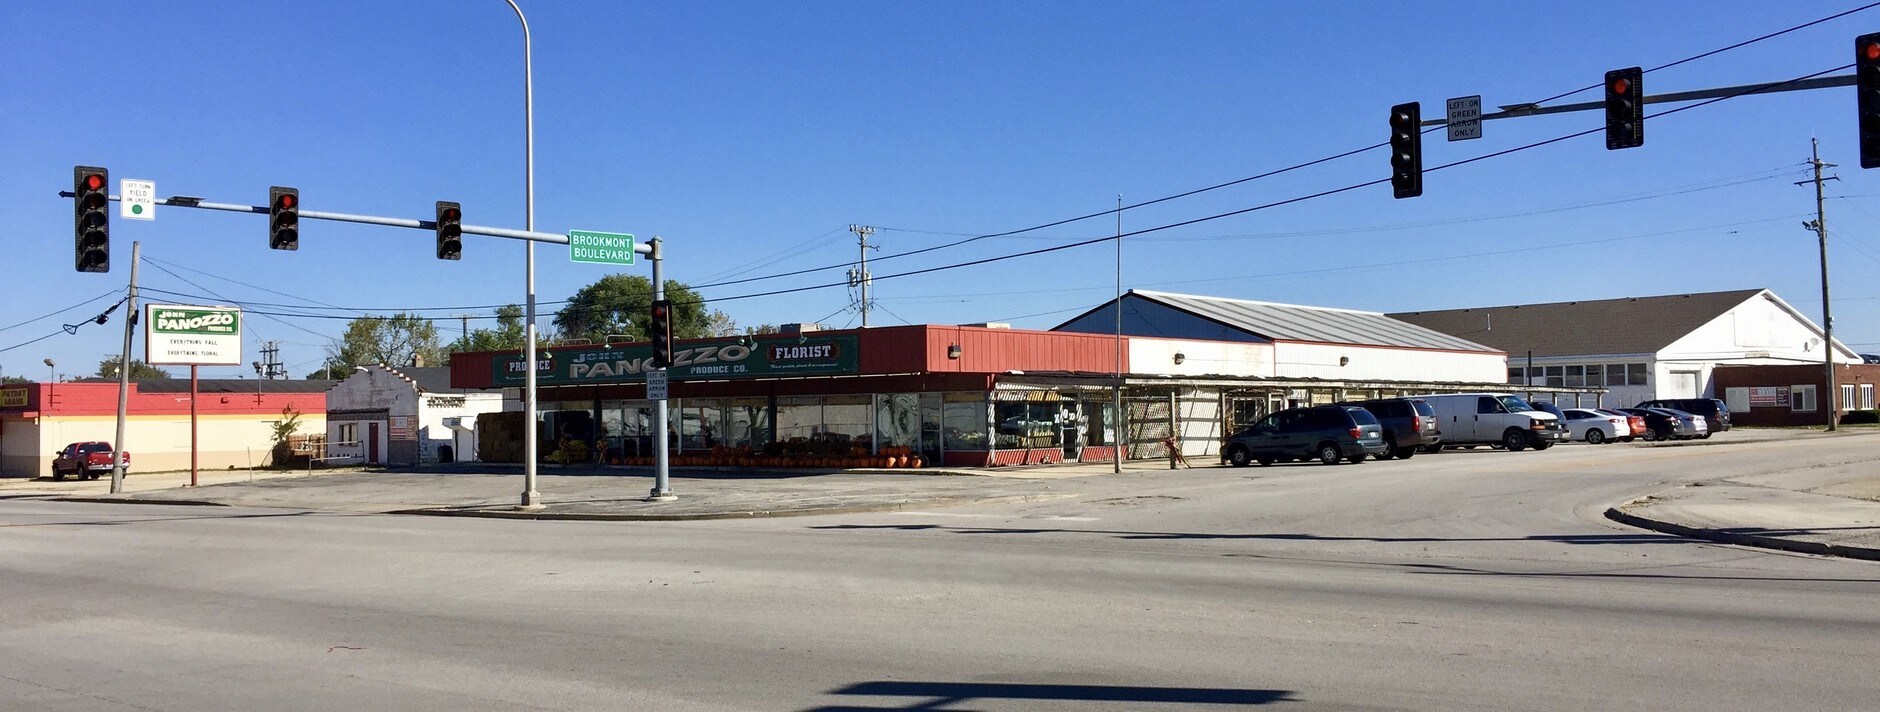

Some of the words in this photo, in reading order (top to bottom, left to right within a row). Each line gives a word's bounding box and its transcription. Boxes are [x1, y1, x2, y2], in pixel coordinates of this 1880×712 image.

[1449, 101, 1464, 109] LEFT
[1469, 99, 1479, 107] ON
[1452, 110, 1476, 118] GREEN
[1451, 119, 1478, 128] ARROW
[1454, 128, 1474, 136] ONLY
[573, 235, 631, 248] BROOKMONT
[574, 247, 631, 260] BOULEVARD
[159, 311, 186, 319] JOHN
[158, 313, 234, 330] PANOZZO
[572, 351, 625, 364] JOHN
[775, 345, 832, 360] FLORIST
[509, 359, 551, 372] PROUCE
[690, 365, 730, 375] PRODUCE
[733, 364, 749, 373] CO.
